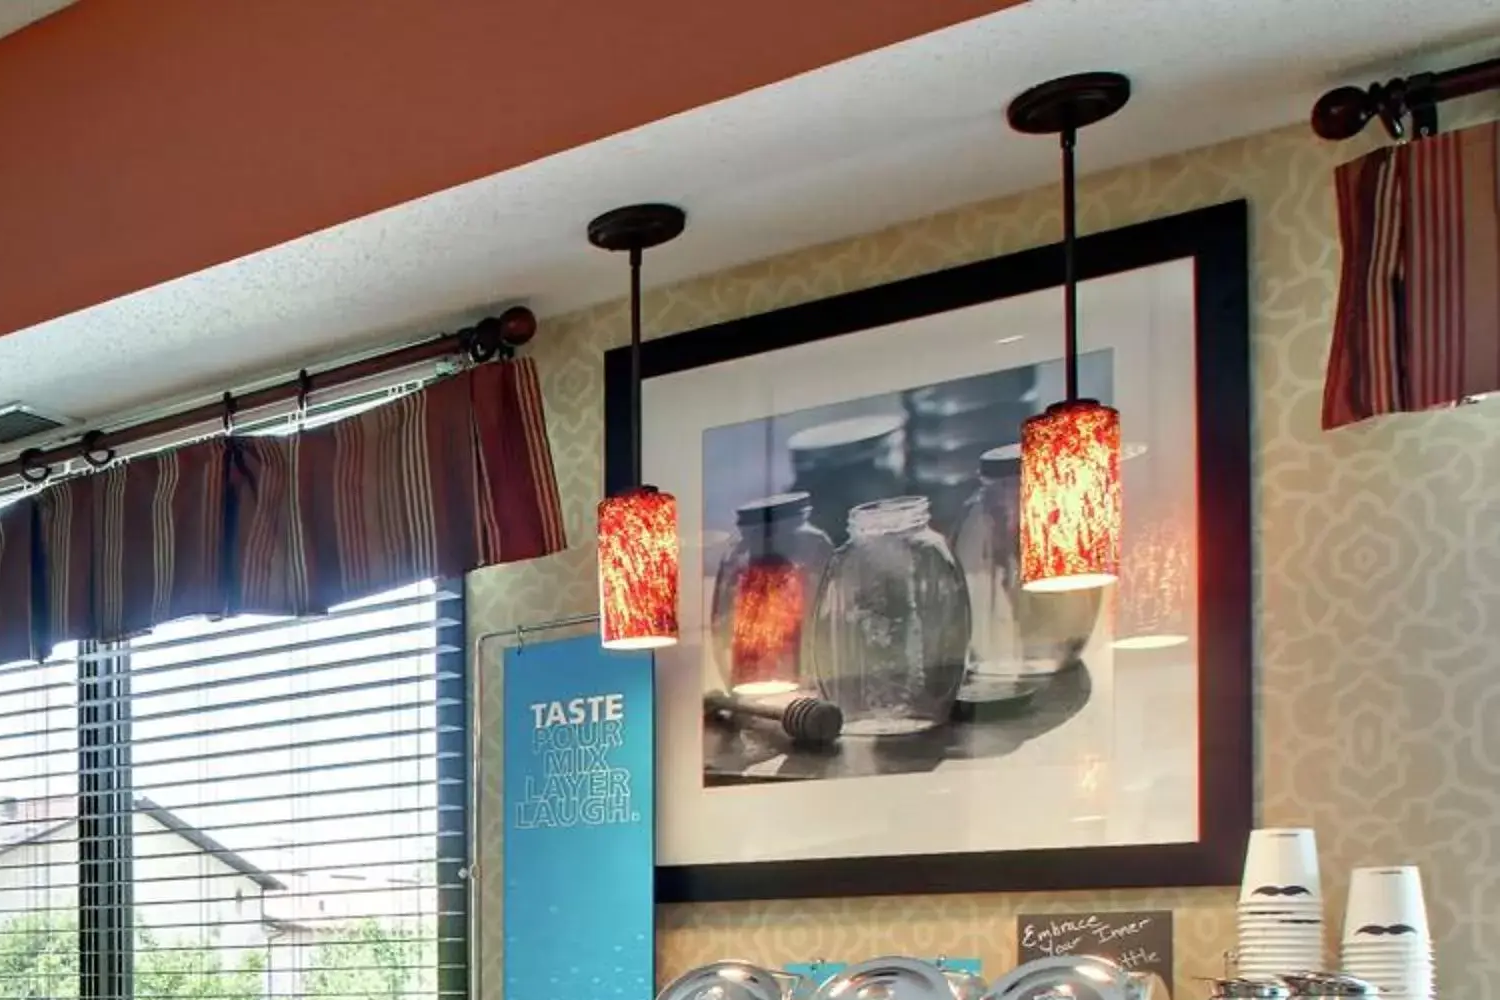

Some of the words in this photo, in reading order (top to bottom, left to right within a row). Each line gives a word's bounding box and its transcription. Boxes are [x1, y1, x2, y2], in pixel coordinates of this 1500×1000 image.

[531, 693, 624, 728] TASTE
[532, 719, 623, 753] POUR
[543, 744, 609, 776] MIX
[525, 768, 631, 803] LAYER
[514, 794, 640, 829] LAUGH.
[1021, 914, 1103, 948] Embrace
[1092, 917, 1152, 945] Inner
